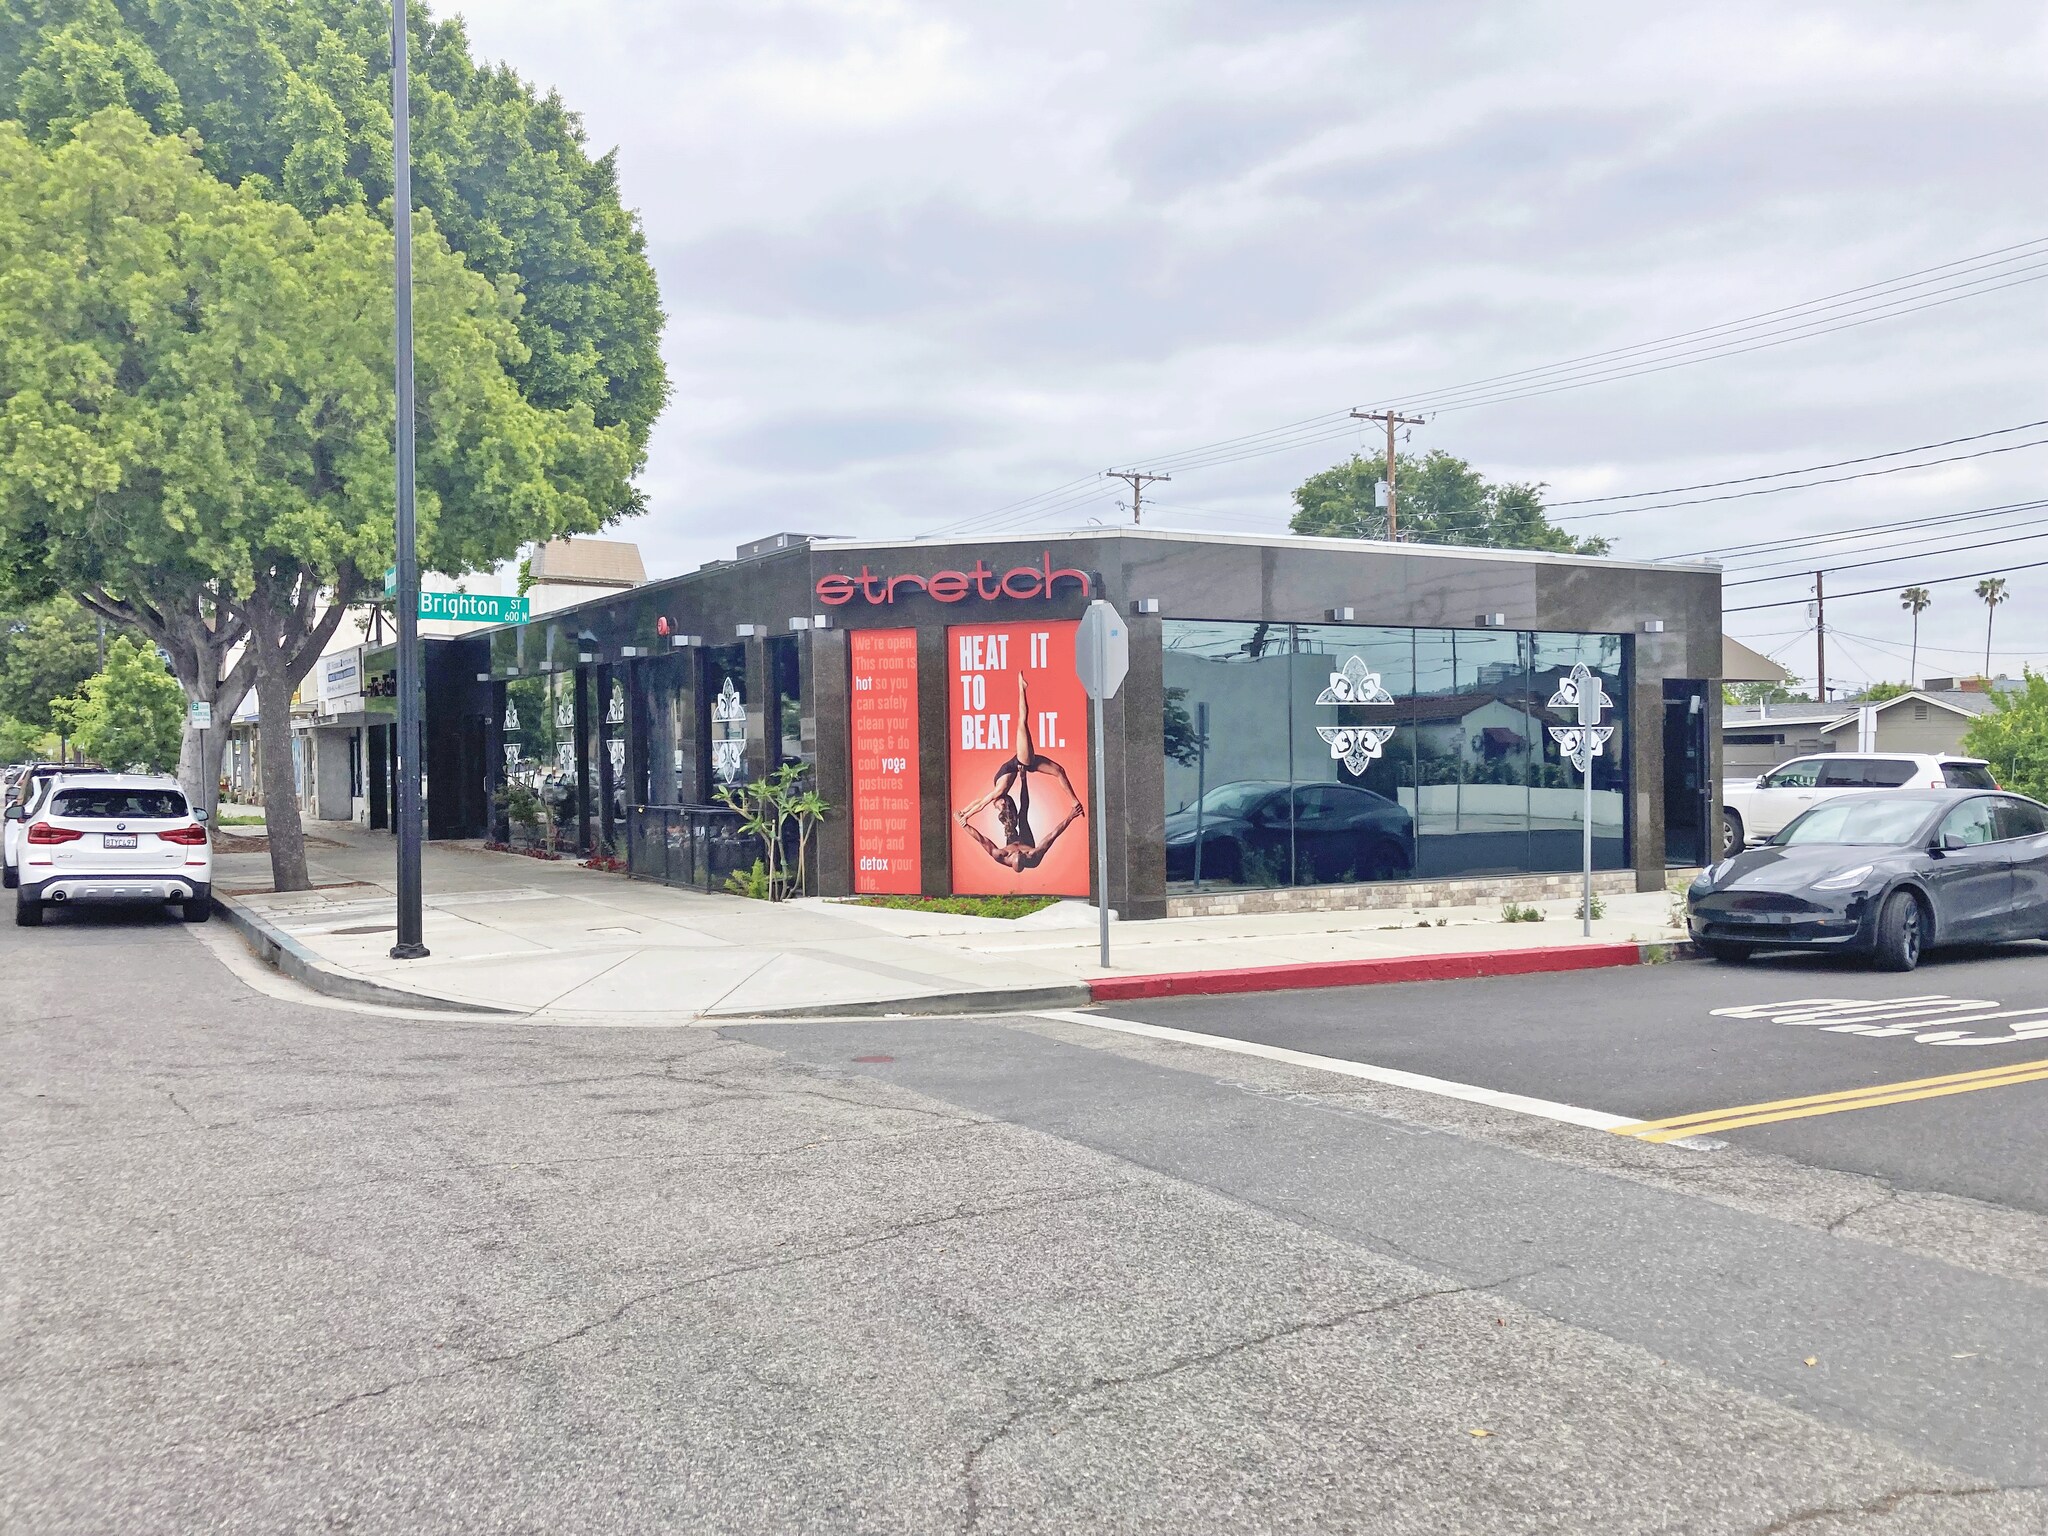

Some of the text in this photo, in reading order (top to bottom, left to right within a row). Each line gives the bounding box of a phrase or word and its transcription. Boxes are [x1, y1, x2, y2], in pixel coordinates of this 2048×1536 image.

[815, 550, 1090, 605] stretch
[420, 593, 522, 620] Brighton ST
[504, 611, 528, 622] 600 N
[855, 636, 915, 653] We're open.
[959, 632, 1050, 671] HEAT IT
[855, 656, 916, 670] This room is
[855, 675, 908, 693] hot so you
[960, 674, 986, 711] TO
[856, 695, 908, 713] can safely
[857, 716, 909, 734] clean your
[961, 711, 1066, 750] BEAT IT.
[857, 735, 910, 755] lungs & do
[858, 755, 906, 774] cool yoga
[859, 776, 903, 795] postures
[859, 795, 914, 811] that trans-
[859, 816, 908, 834] form your
[859, 835, 905, 854] body and
[860, 855, 914, 874] detox your
[860, 875, 880, 891] life.
